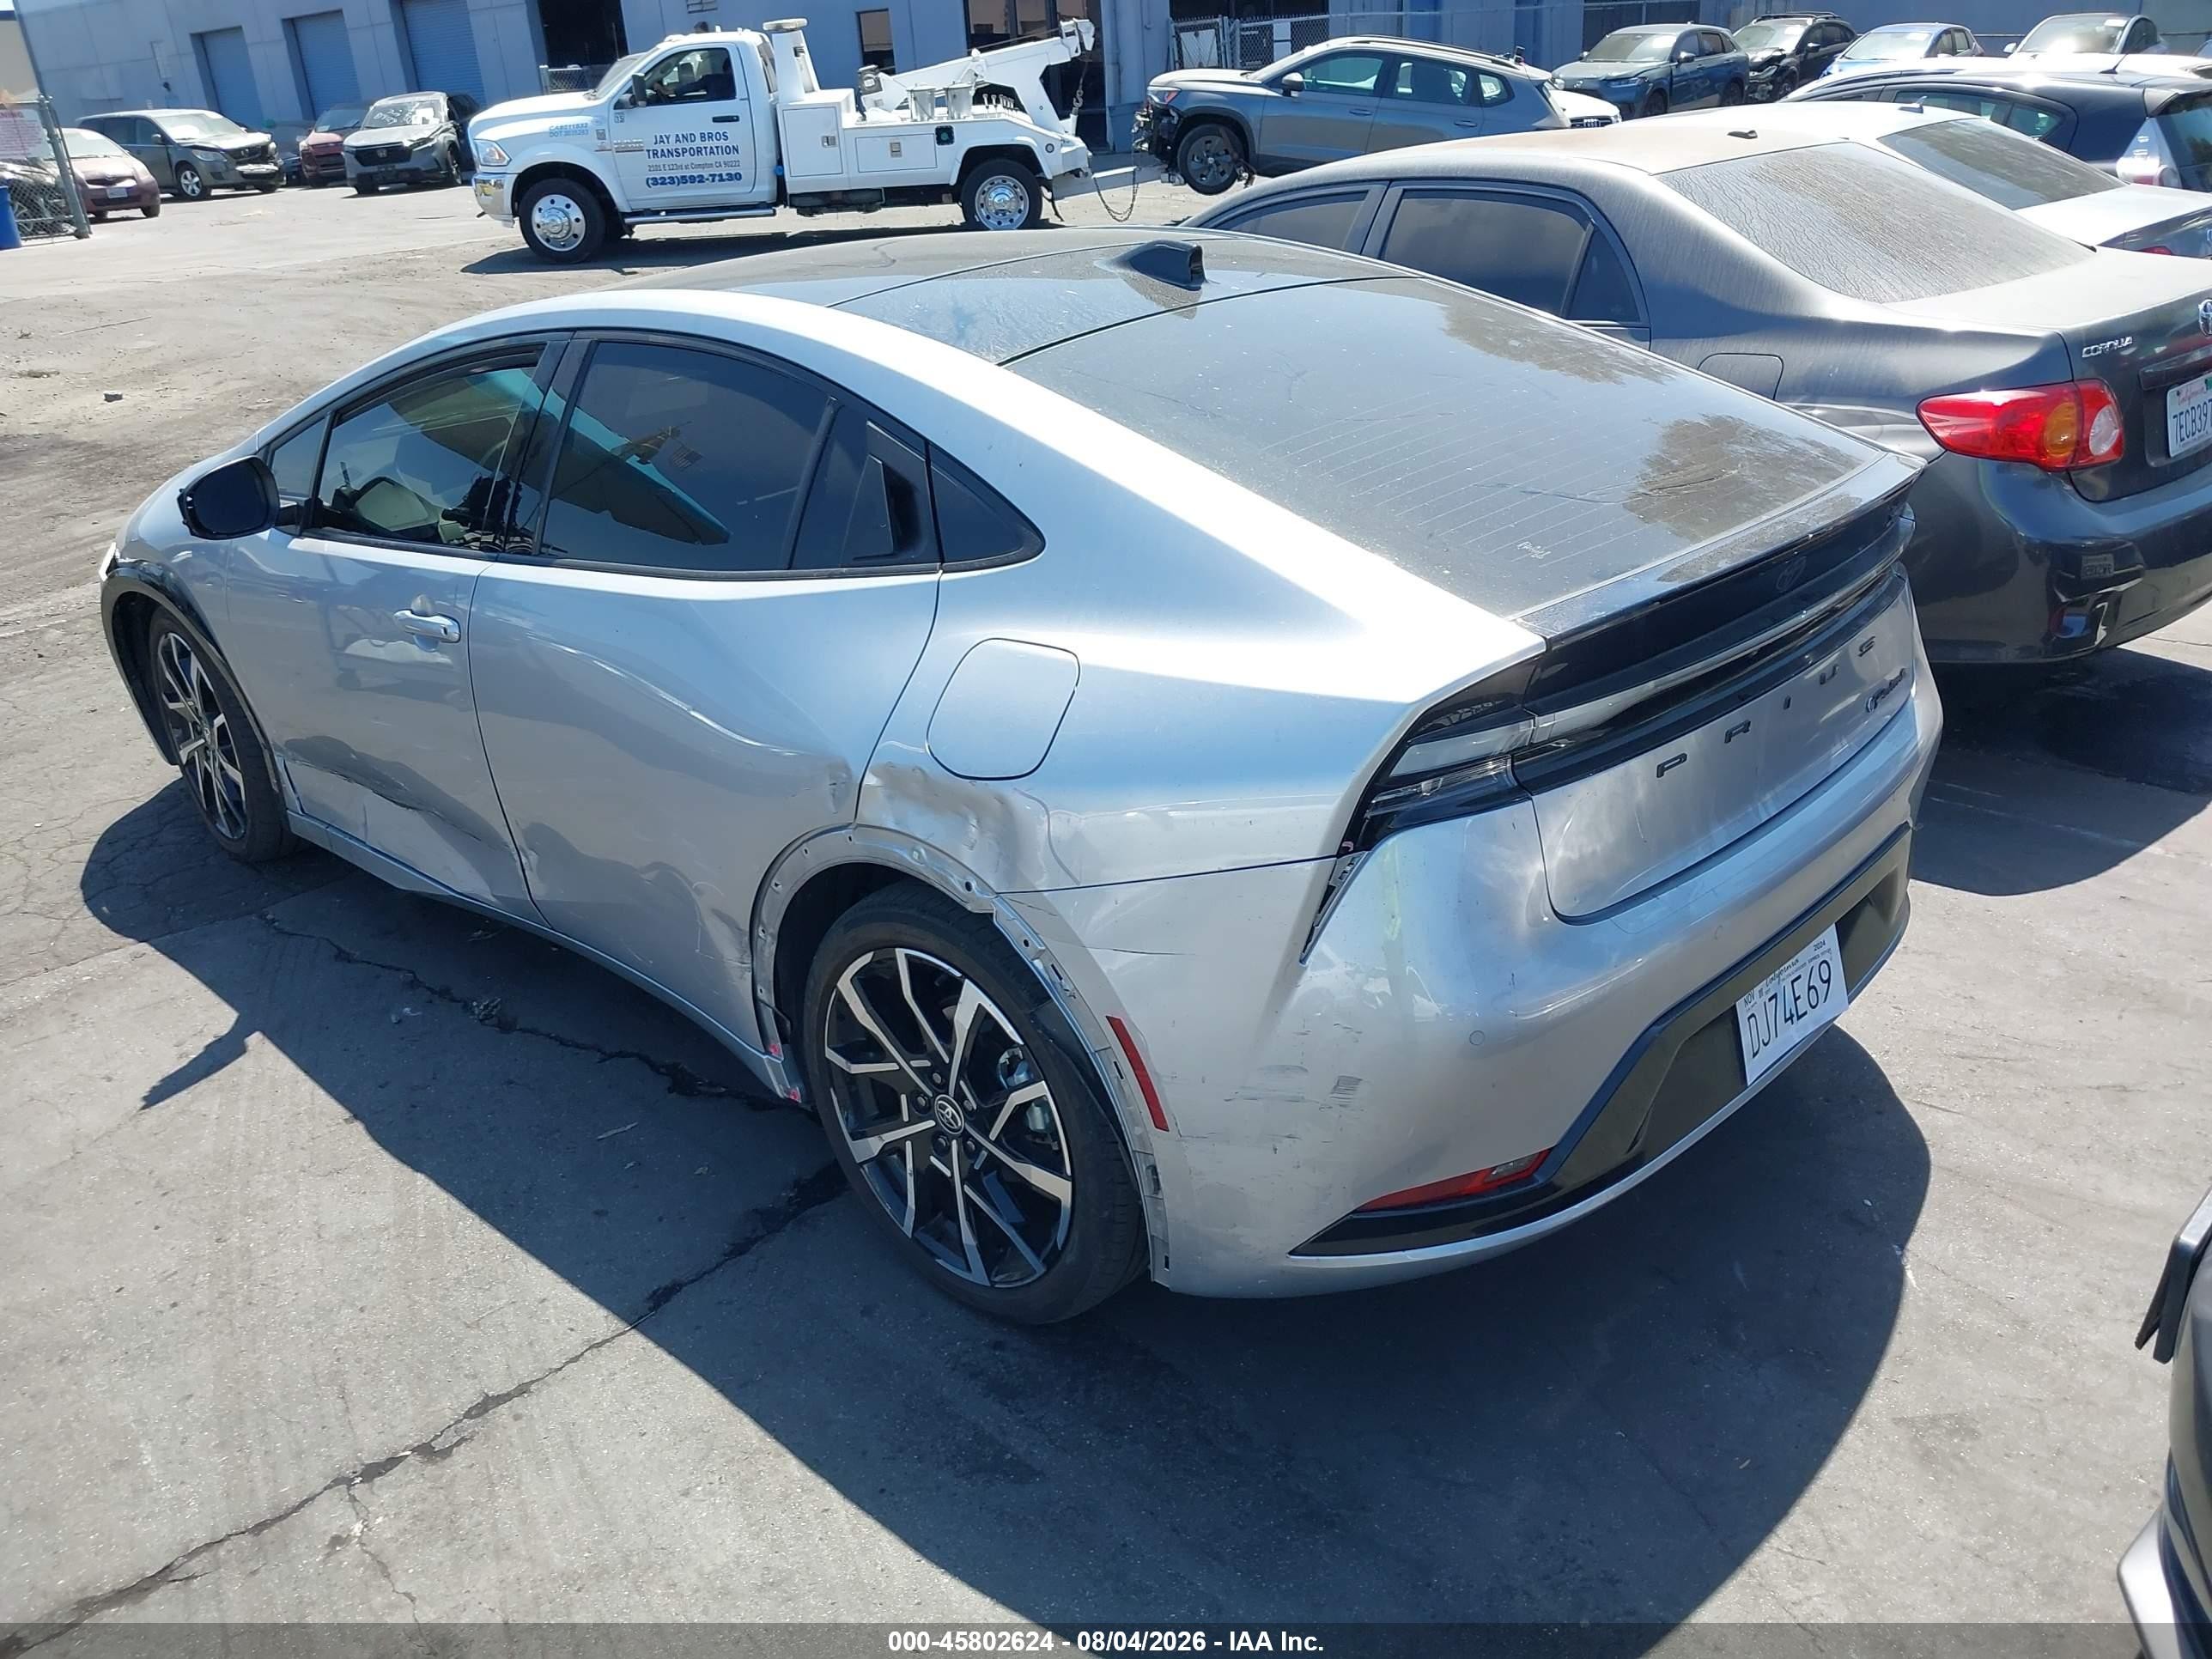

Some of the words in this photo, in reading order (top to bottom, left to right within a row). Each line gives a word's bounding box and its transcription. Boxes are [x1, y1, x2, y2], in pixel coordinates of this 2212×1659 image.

[653, 134, 671, 145] JAY
[674, 132, 696, 144] AND
[700, 131, 729, 143] BROS
[646, 144, 739, 160] TRANSPORTATION
[646, 172, 743, 188] (323)592-7130
[1747, 959, 1832, 1060] DJ74E69
